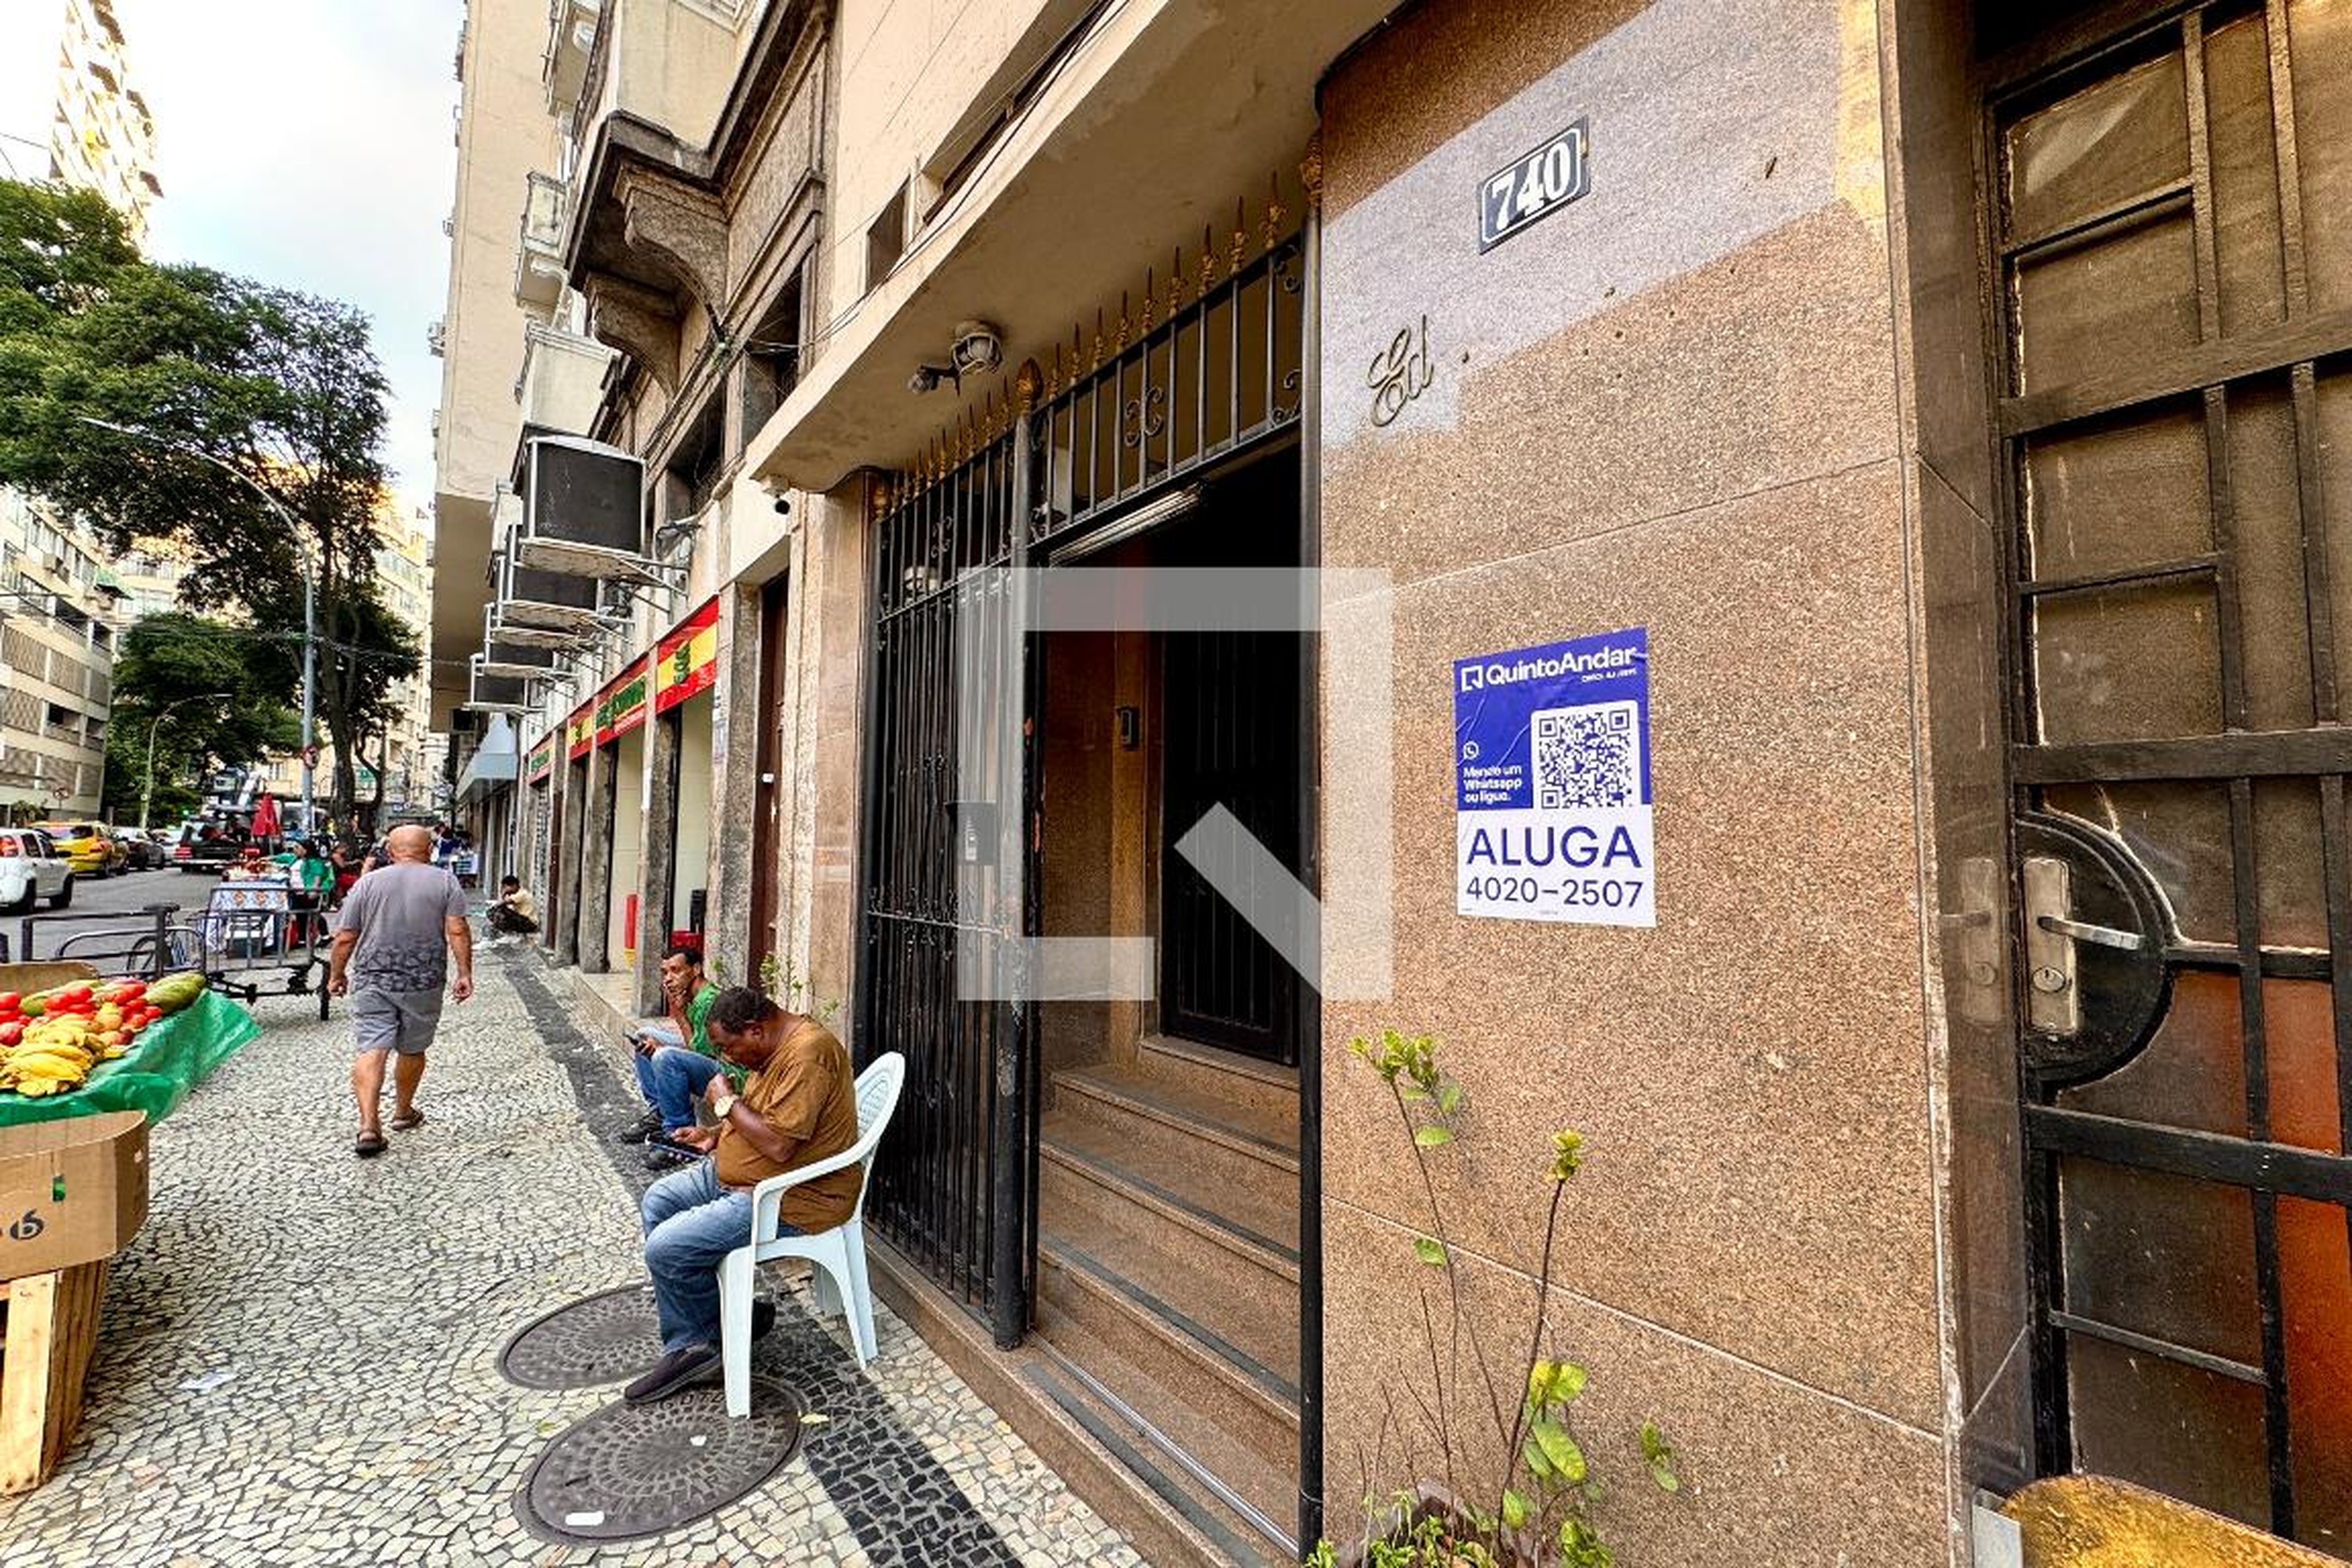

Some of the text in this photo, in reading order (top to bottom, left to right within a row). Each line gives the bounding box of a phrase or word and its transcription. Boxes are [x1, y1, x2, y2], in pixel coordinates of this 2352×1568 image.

[1492, 142, 1571, 230] 740
[1368, 314, 1434, 424] Ed
[1487, 647, 1637, 685] QuintoAndar
[1503, 765, 1522, 775] um
[1466, 826, 1642, 867] ALUGA
[1466, 876, 1643, 908] 4020-2507
